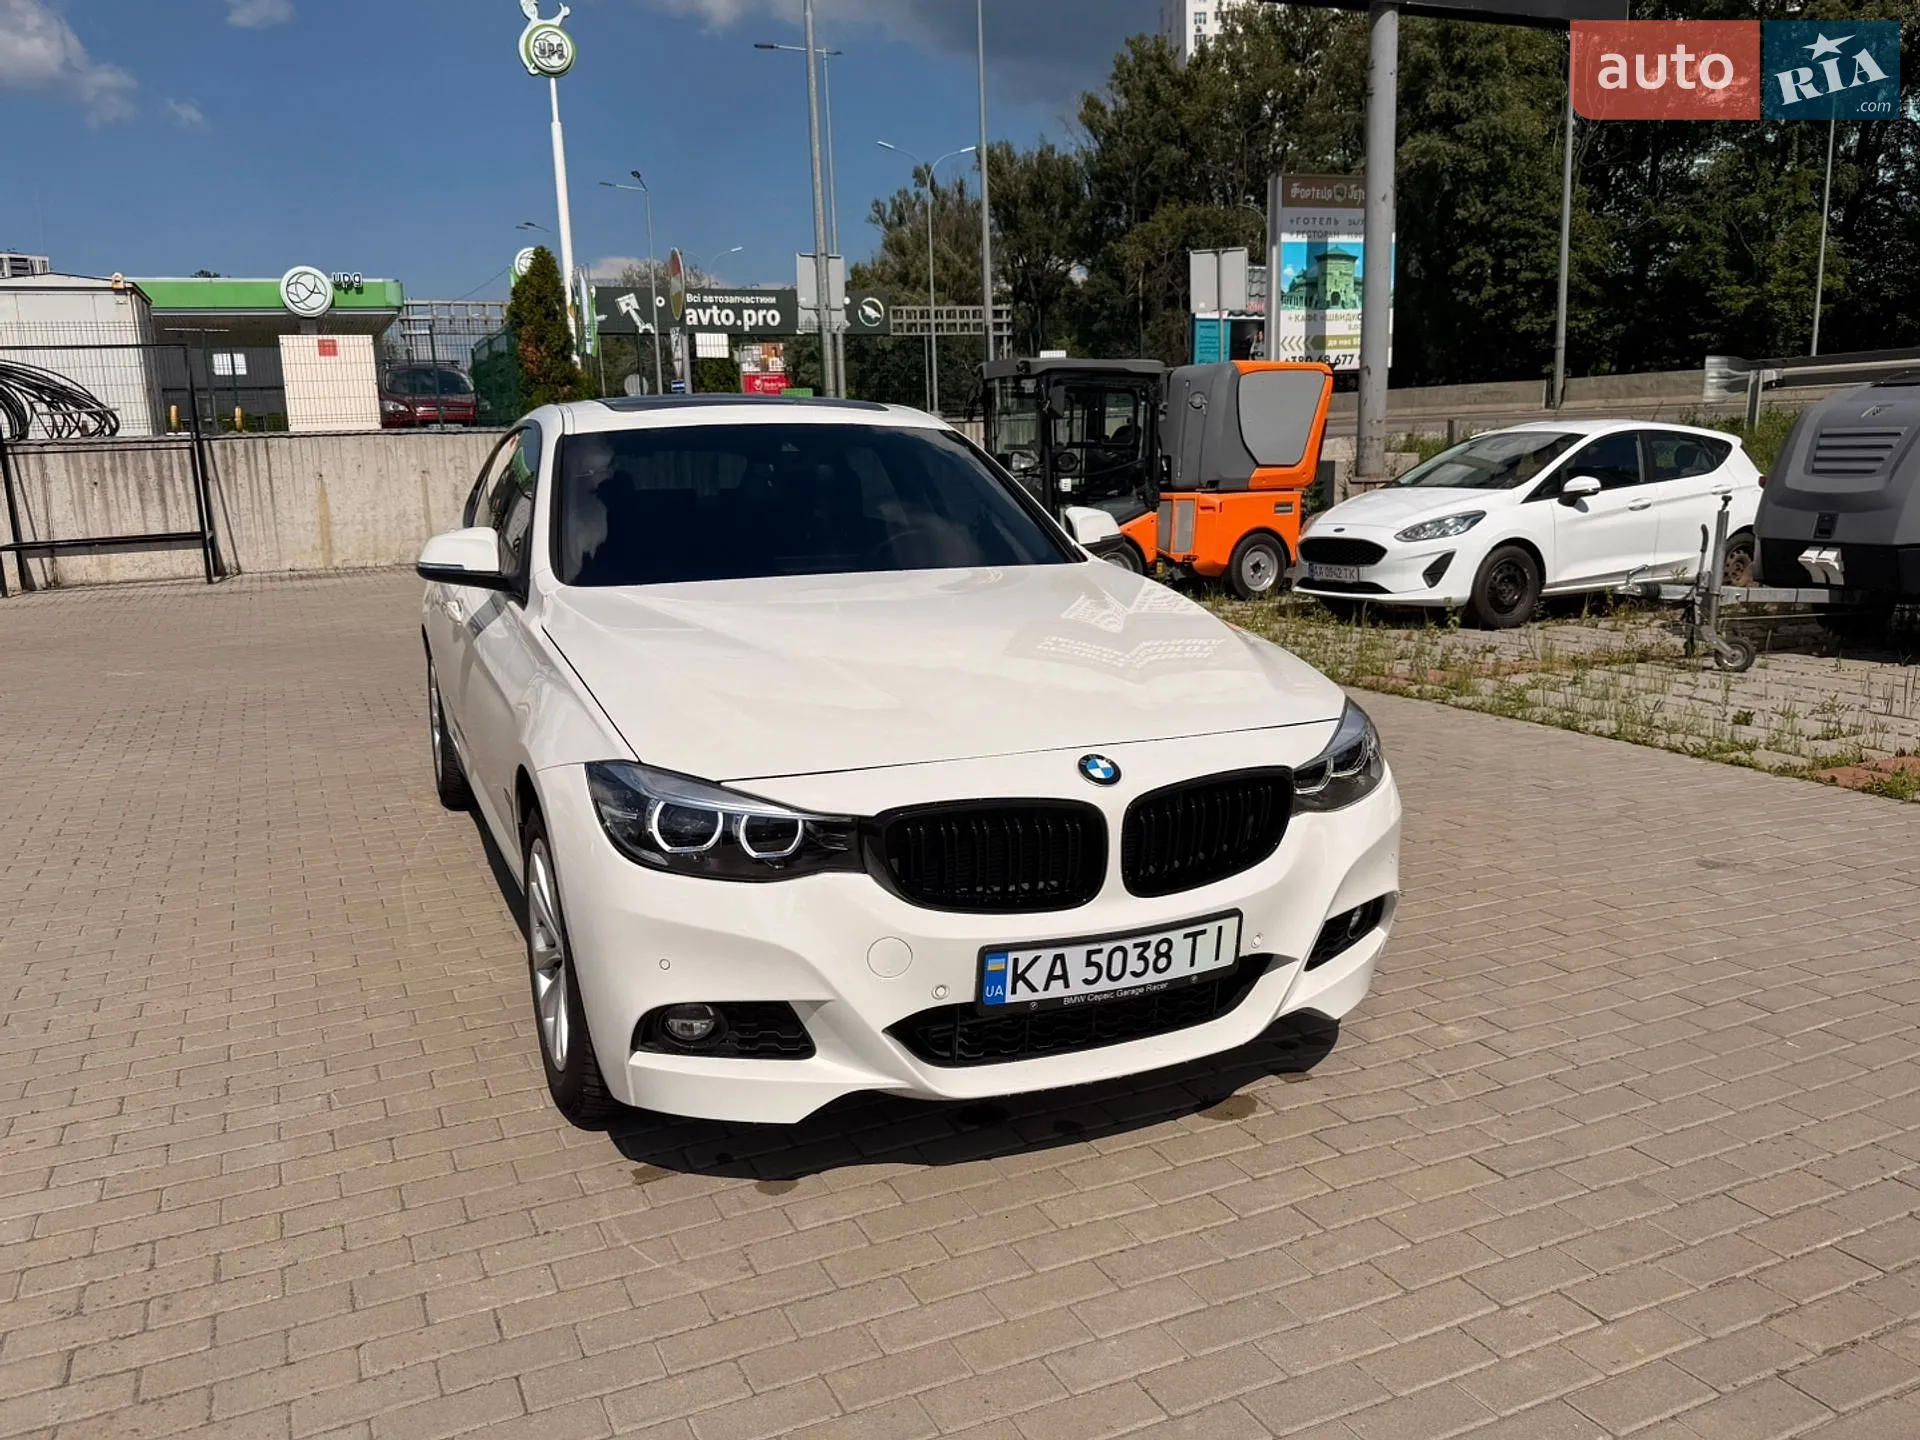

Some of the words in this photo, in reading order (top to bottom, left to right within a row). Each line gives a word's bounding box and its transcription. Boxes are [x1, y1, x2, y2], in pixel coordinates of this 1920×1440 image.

[538, 42, 565, 60] upg
[331, 272, 363, 288] upg
[686, 293, 701, 303] Всі
[703, 294, 776, 304] автозапчастини
[685, 305, 781, 332] avto.pro
[1334, 353, 1355, 365] 677
[1010, 952, 1070, 996] KA
[1082, 937, 1174, 987] 5038
[1183, 924, 1224, 968] TI
[985, 984, 1004, 999] UA
[1116, 986, 1145, 998] Garage
